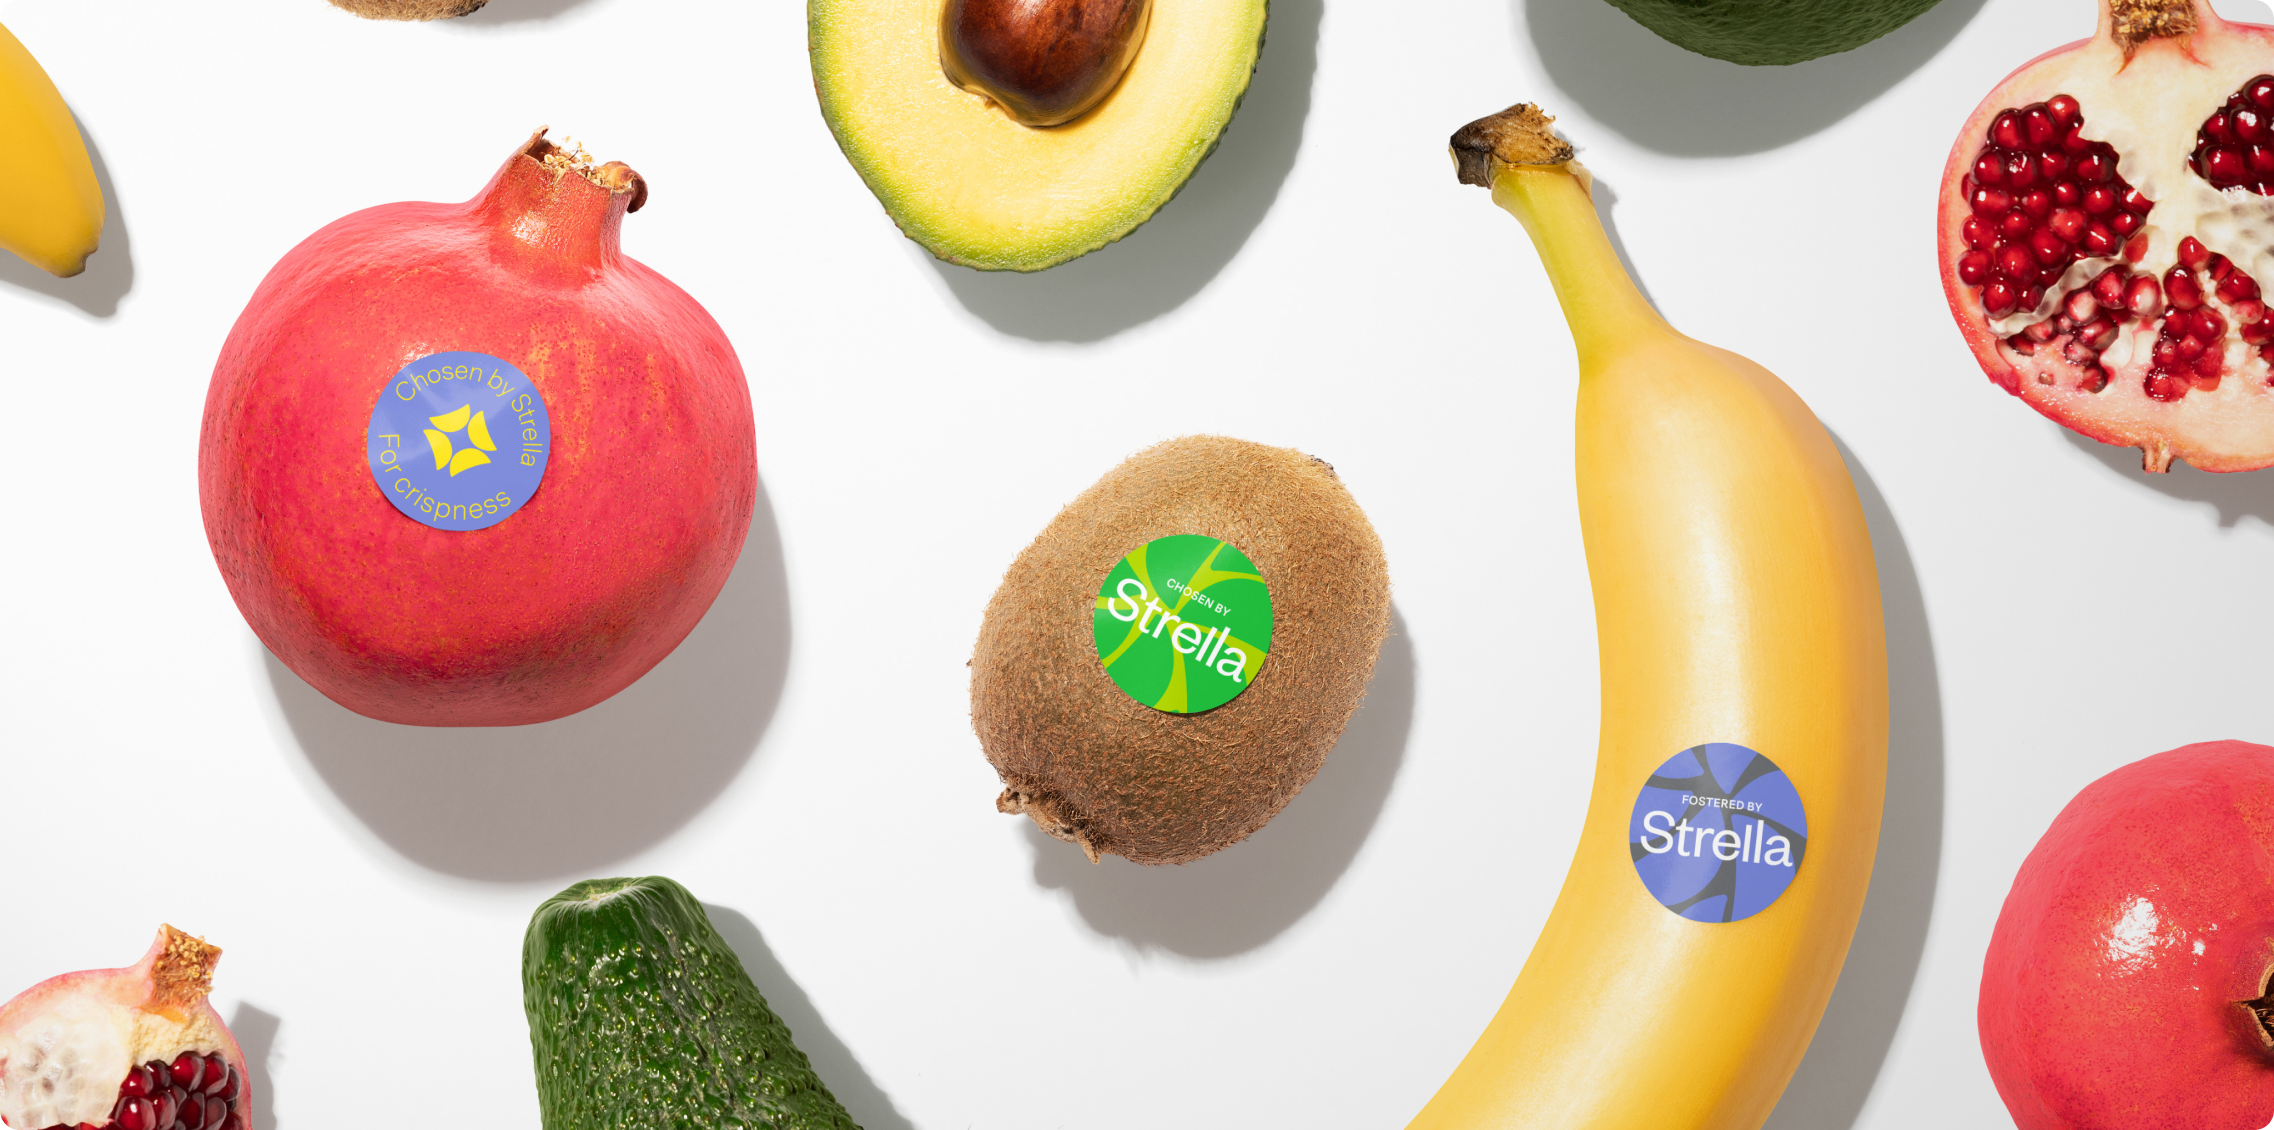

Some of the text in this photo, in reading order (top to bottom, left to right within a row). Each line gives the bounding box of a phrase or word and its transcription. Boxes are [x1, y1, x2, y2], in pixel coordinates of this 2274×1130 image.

[396, 365, 543, 467] Chosen by Strella
[378, 434, 511, 522] For crispness
[1107, 578, 1247, 683] Strella
[1166, 578, 1231, 617] CHOSEN BY
[1640, 810, 1793, 867] Strella
[1681, 794, 1763, 812] FOSTERED BY
